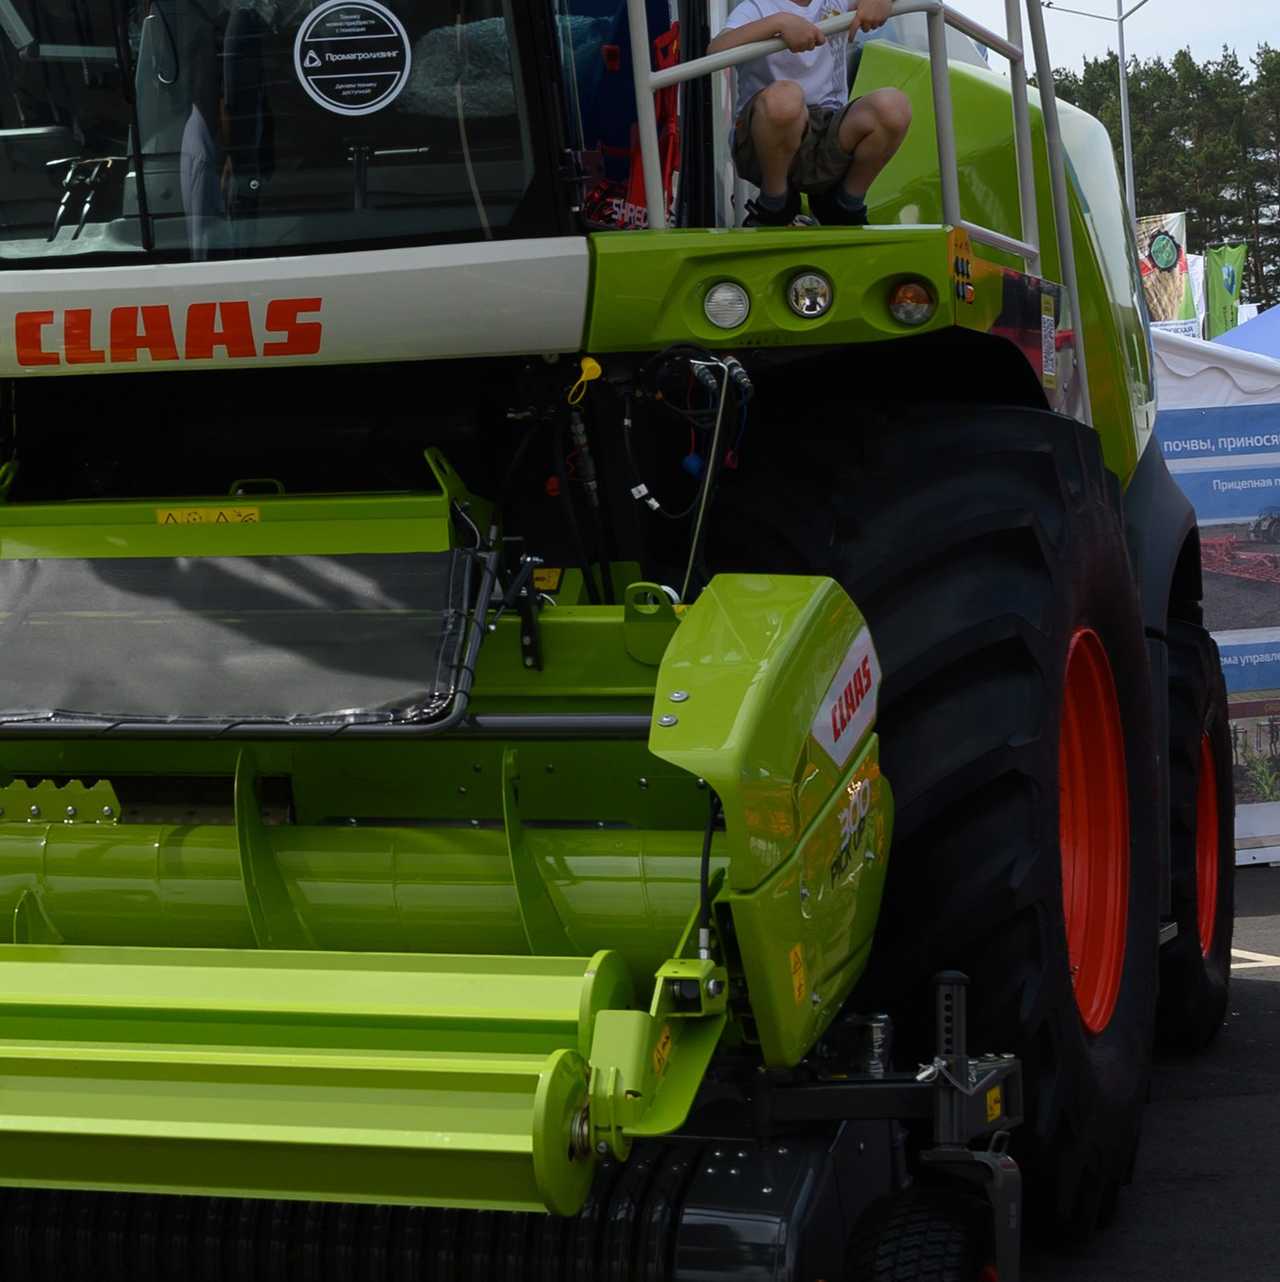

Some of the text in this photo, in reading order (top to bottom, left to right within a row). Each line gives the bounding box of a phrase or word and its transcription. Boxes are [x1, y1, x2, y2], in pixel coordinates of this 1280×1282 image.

[325, 51, 399, 61] Промагролизинг
[14, 297, 323, 366] CLAAS
[1163, 434, 1280, 452] почвы, принося
[1213, 478, 1272, 492] Прицепная
[829, 654, 872, 744] CLAAS
[838, 777, 870, 851] 300
